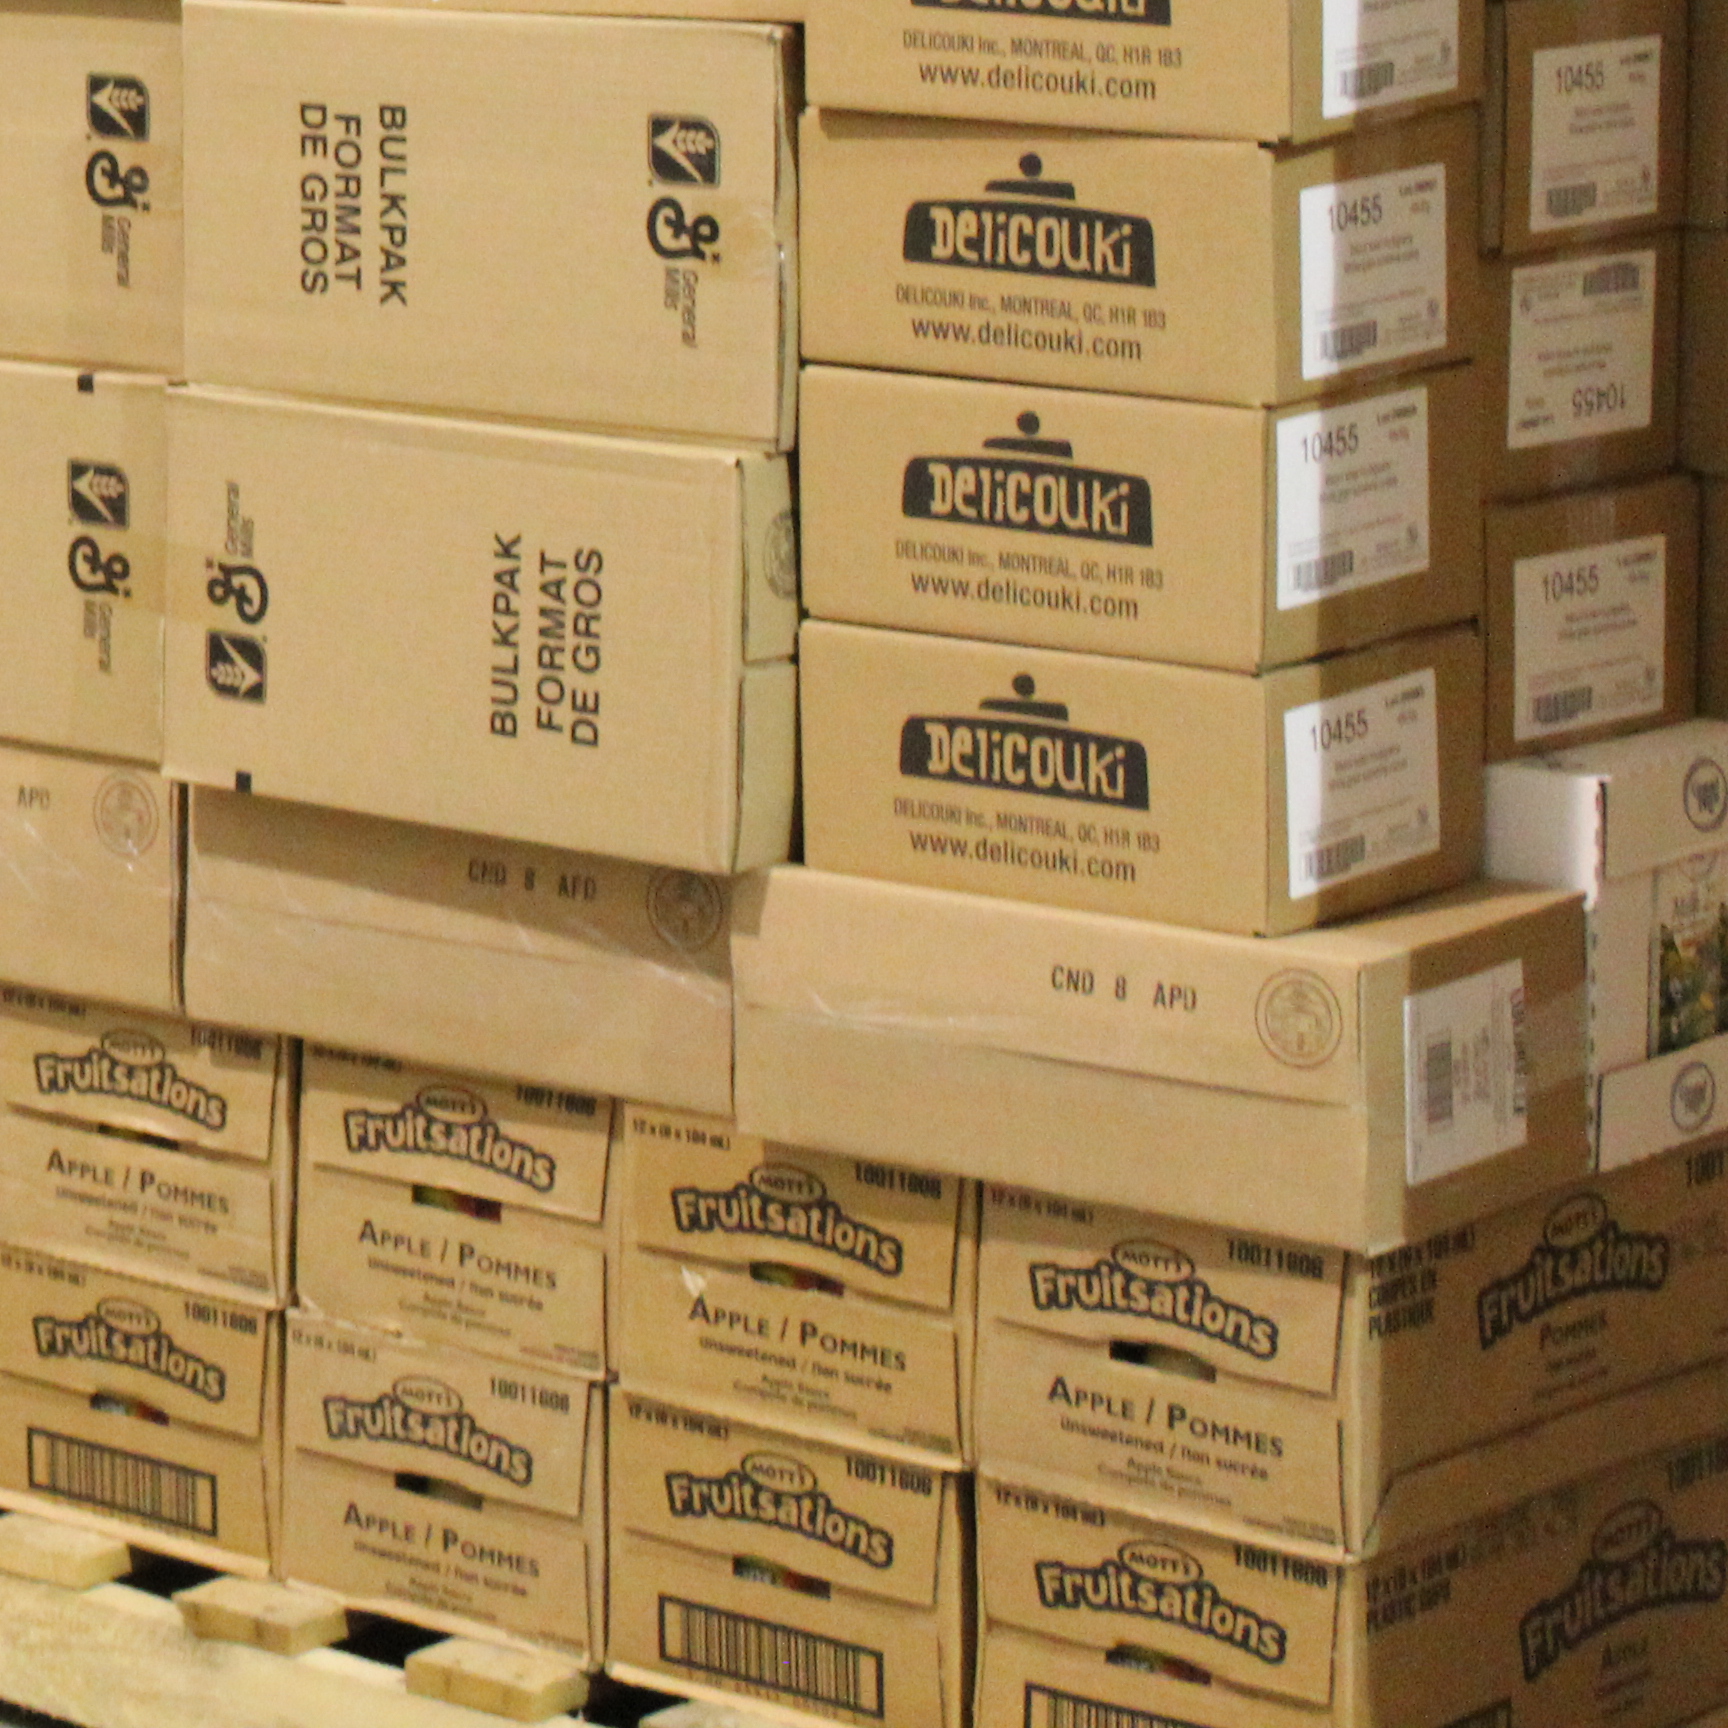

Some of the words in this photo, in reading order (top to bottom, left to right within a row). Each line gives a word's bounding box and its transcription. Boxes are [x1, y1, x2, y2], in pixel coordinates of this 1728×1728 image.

[903, 29, 974, 52] DELICOUKI
[1556, 61, 1604, 93] 10455
[919, 62, 1156, 100] www.delicouki.com
[300, 102, 327, 158] DE
[300, 174, 328, 296] GROS
[334, 113, 362, 290] FORMAT
[379, 104, 408, 307] BULKPAK
[1329, 193, 1382, 231] 10455
[682, 272, 699, 349] General
[896, 283, 964, 307] DELICOUKI
[911, 318, 1142, 361] www.delicouki.com
[1303, 422, 1359, 463] 10455
[225, 481, 239, 555] General
[895, 539, 964, 566] DELICOUKI
[573, 547, 603, 674] GROS
[911, 572, 1139, 620] www.delicouki.com
[1543, 565, 1599, 603] 10455
[490, 532, 522, 738] BULKPAK
[537, 550, 567, 733] FORMAT
[571, 691, 599, 747] DE
[1311, 708, 1369, 753] 10455
[894, 796, 961, 824] DELICOUKI
[909, 830, 1136, 882] www.delicouki.com
[35, 1048, 227, 1131] Fruitsations
[345, 1104, 556, 1193] Fruitsations
[672, 1182, 903, 1278] Fruitsations
[1030, 1259, 1278, 1361] Fruitsations
[33, 1314, 226, 1403] Fruitsations
[324, 1394, 533, 1486] Fruitsations
[666, 1468, 893, 1569] Fruitsations
[1036, 1561, 1287, 1665] Fruitsations
